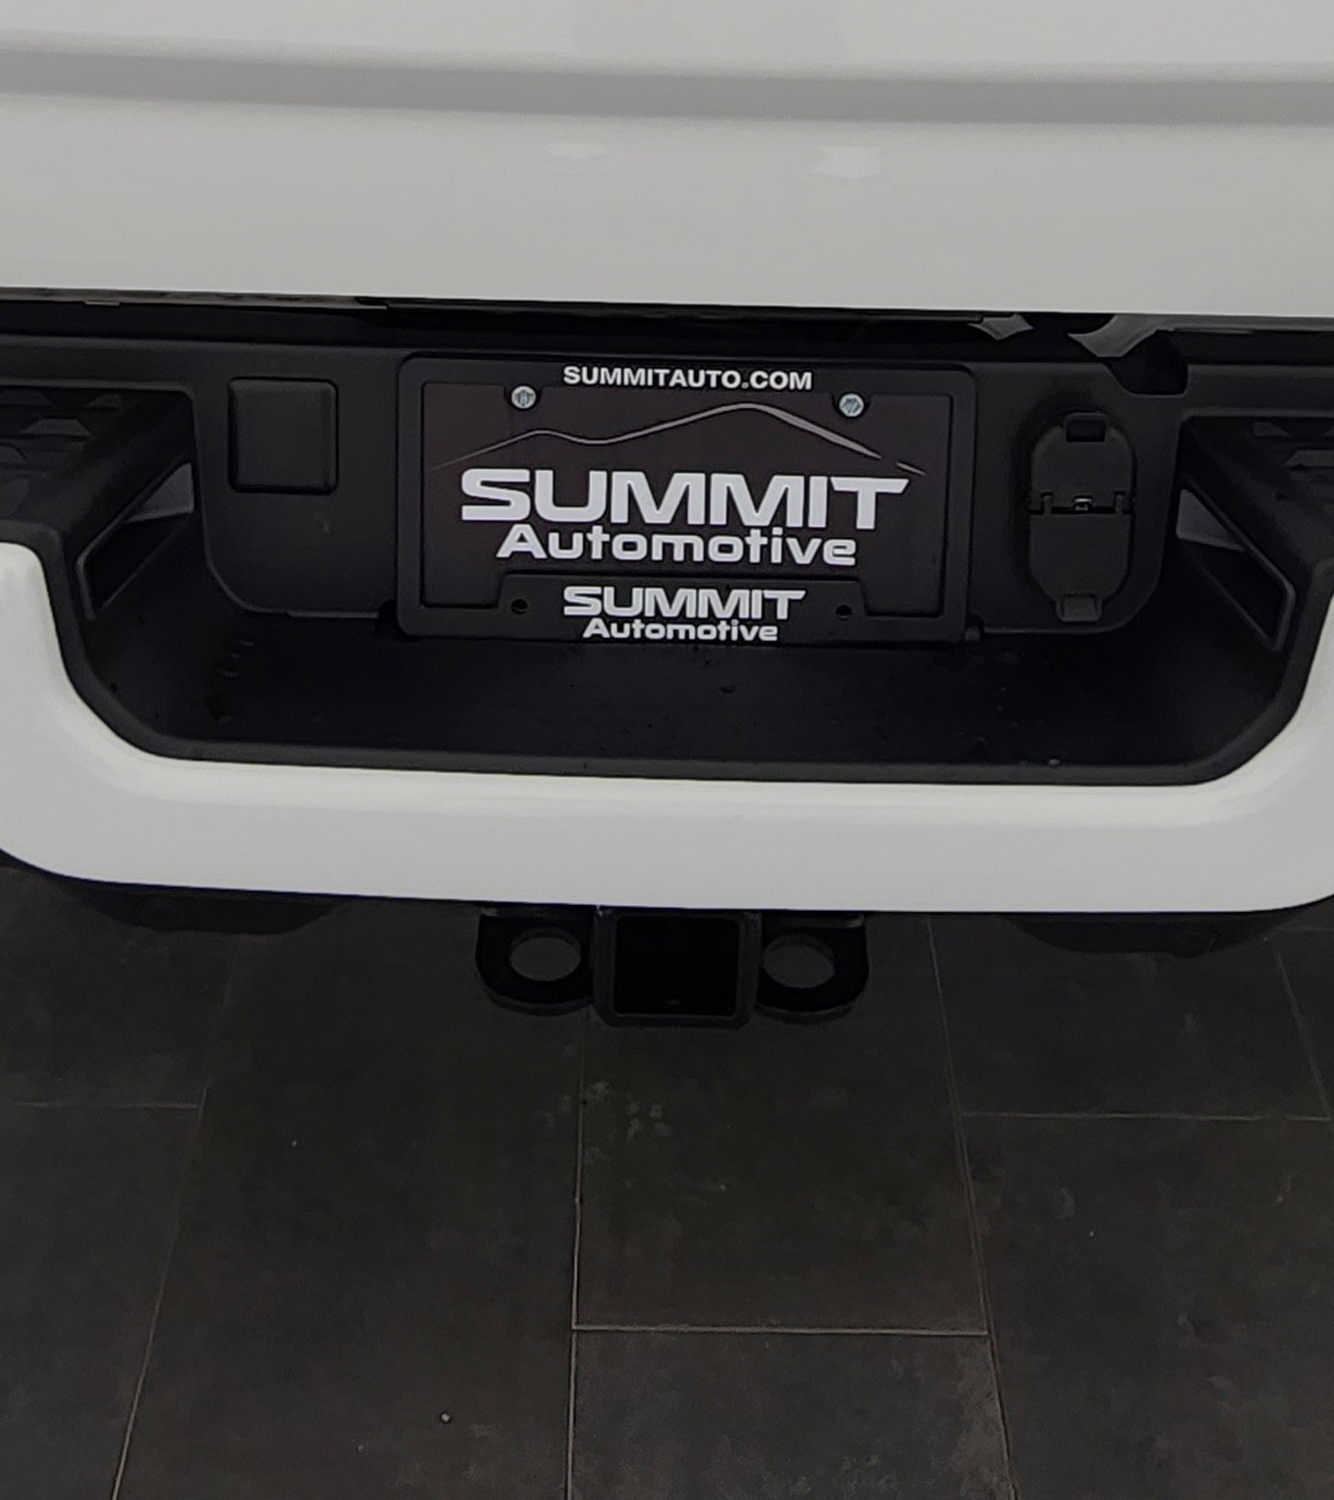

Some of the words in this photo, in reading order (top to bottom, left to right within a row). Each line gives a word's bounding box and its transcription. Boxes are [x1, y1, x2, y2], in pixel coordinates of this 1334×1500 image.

[563, 366, 813, 390] SUMMITAUTO.COM
[461, 468, 909, 530] SUMMIT
[496, 524, 857, 566] Automotive
[563, 586, 805, 620] SUMMIT
[583, 618, 779, 641] Automotive
